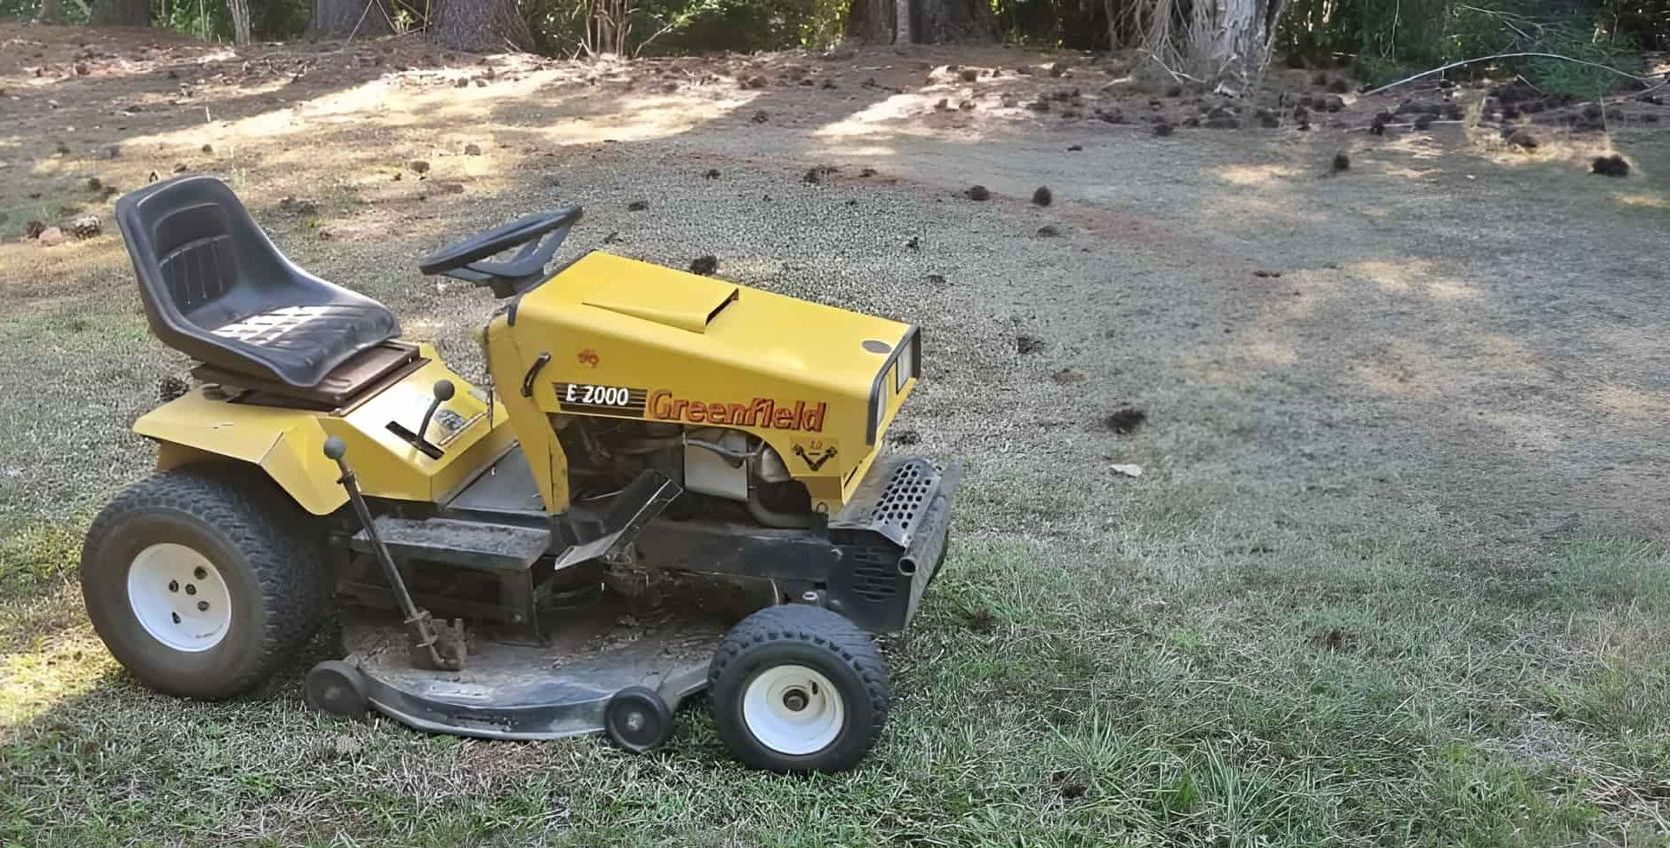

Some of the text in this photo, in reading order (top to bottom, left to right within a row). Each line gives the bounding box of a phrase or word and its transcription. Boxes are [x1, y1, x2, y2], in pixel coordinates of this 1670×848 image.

[566, 383, 629, 406] E 2000
[650, 389, 827, 432] Greenfield
